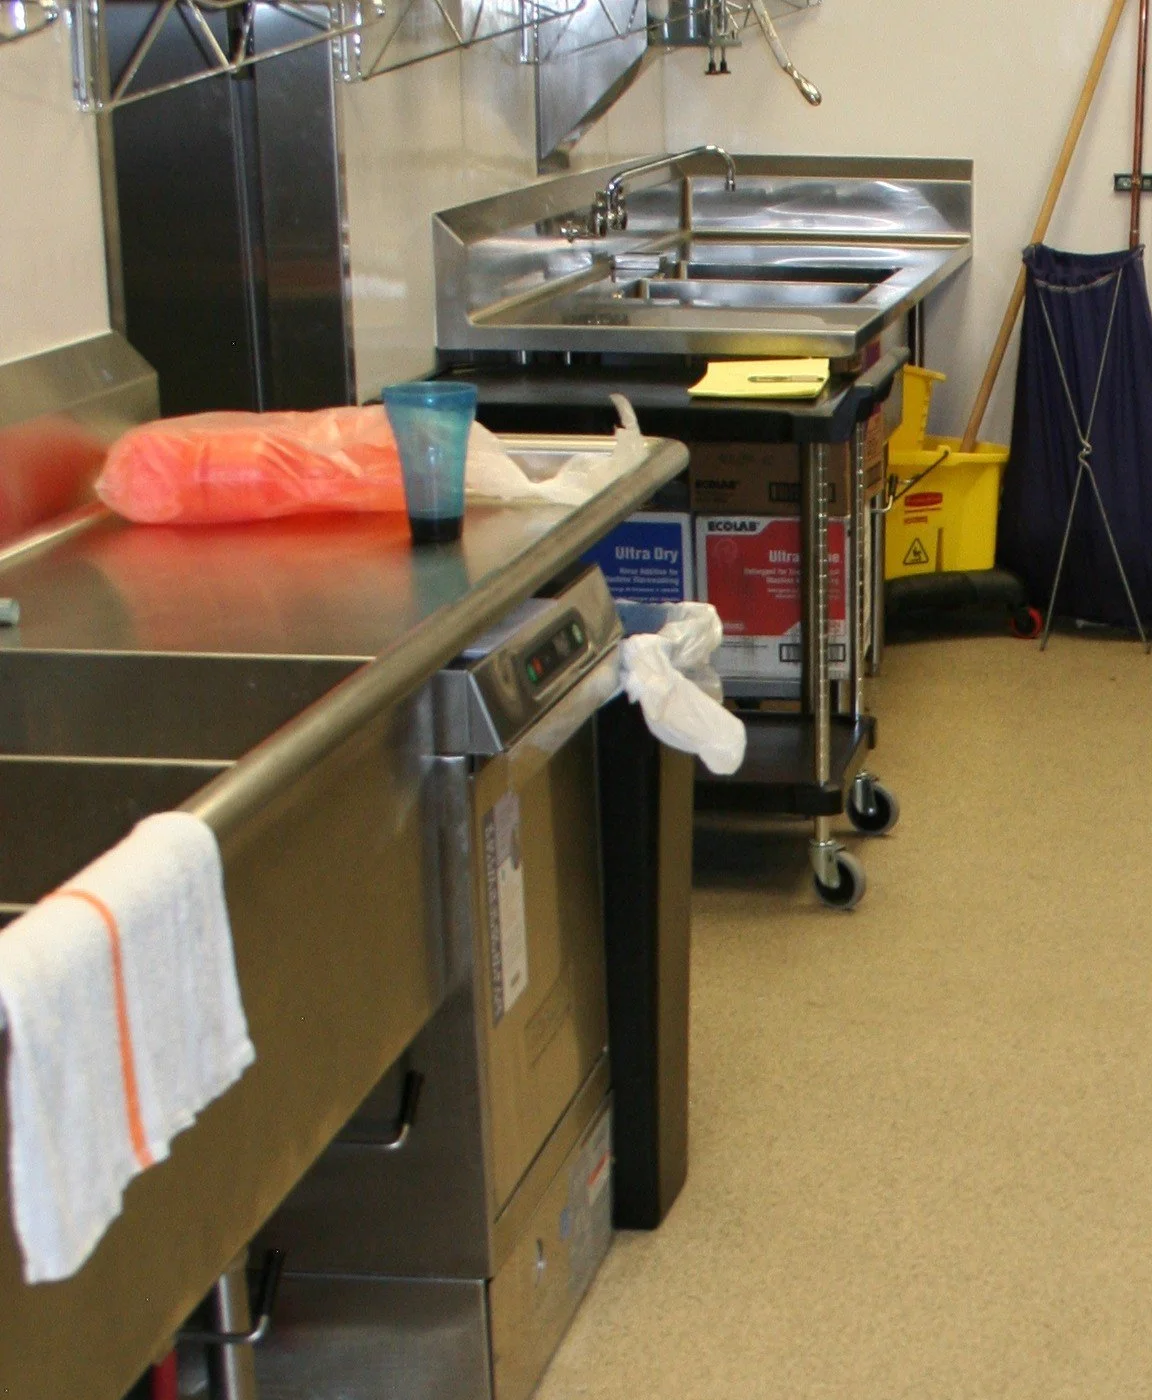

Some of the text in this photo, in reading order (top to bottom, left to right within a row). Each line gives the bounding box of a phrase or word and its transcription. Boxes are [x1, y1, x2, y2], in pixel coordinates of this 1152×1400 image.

[707, 520, 758, 532] ECOLAB
[615, 545, 679, 565] Ultra Dry
[769, 549, 800, 563] Ultra
